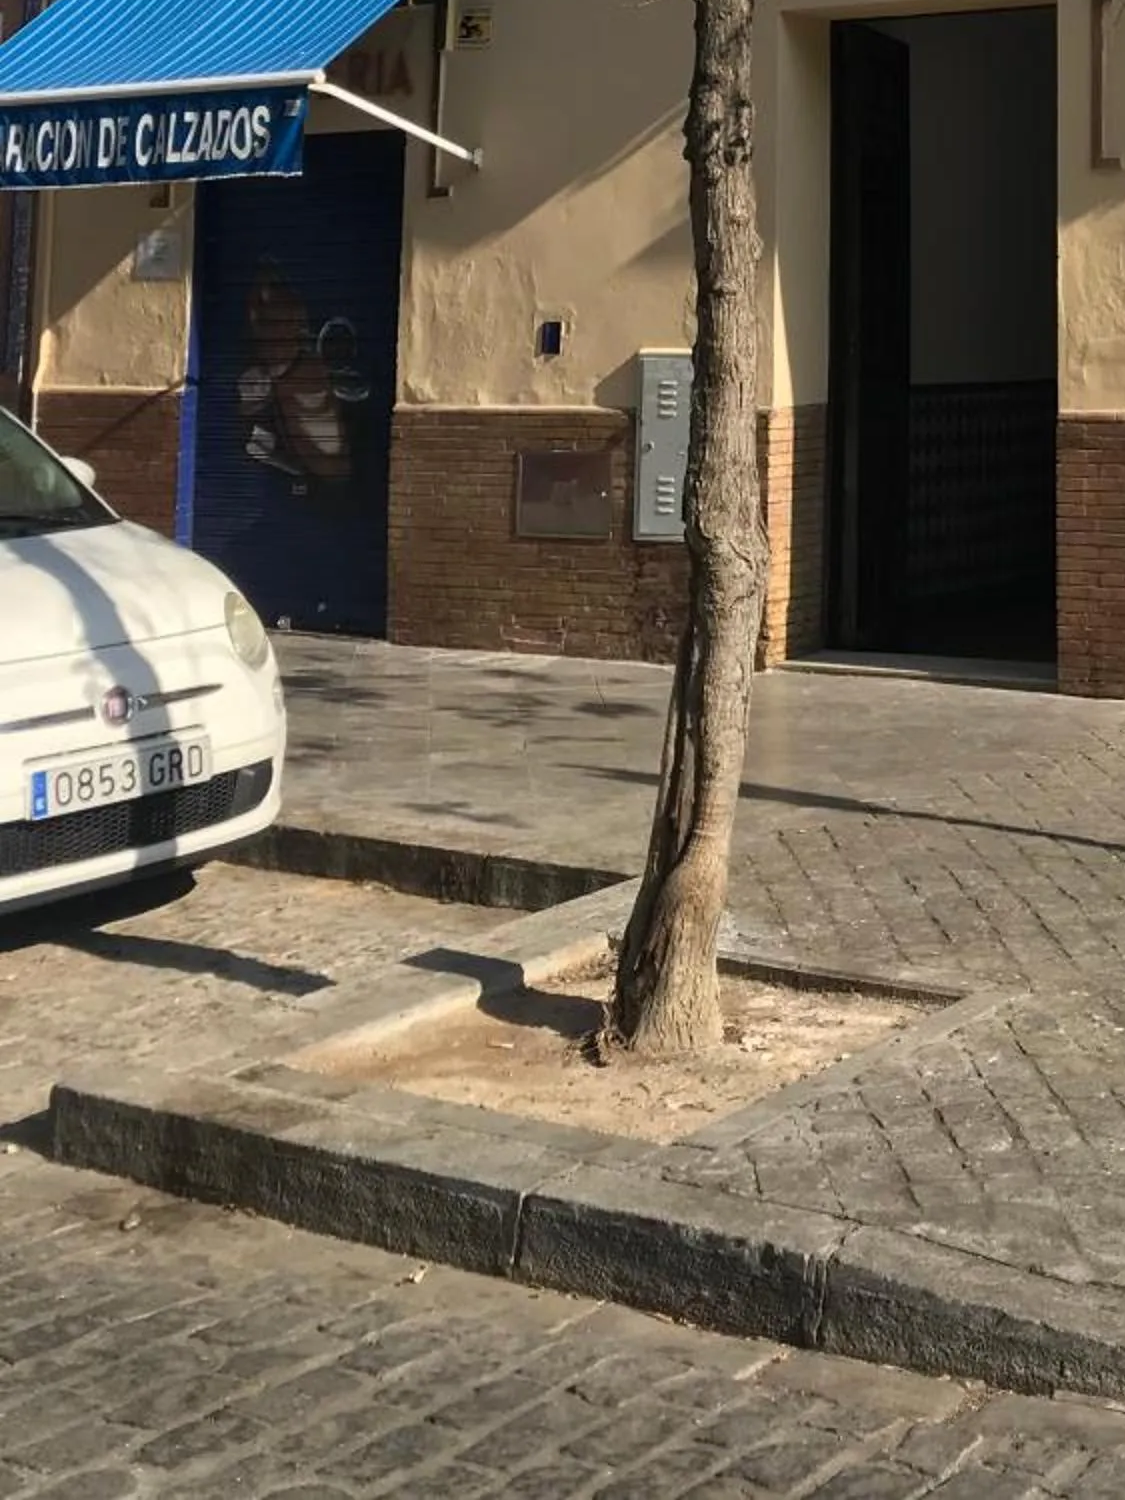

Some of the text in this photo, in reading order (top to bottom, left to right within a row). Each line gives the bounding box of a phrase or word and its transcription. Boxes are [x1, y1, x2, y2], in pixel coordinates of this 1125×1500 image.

[0, 105, 271, 174] RACION DE CALZADOS
[54, 745, 203, 807] 0853 GRD
